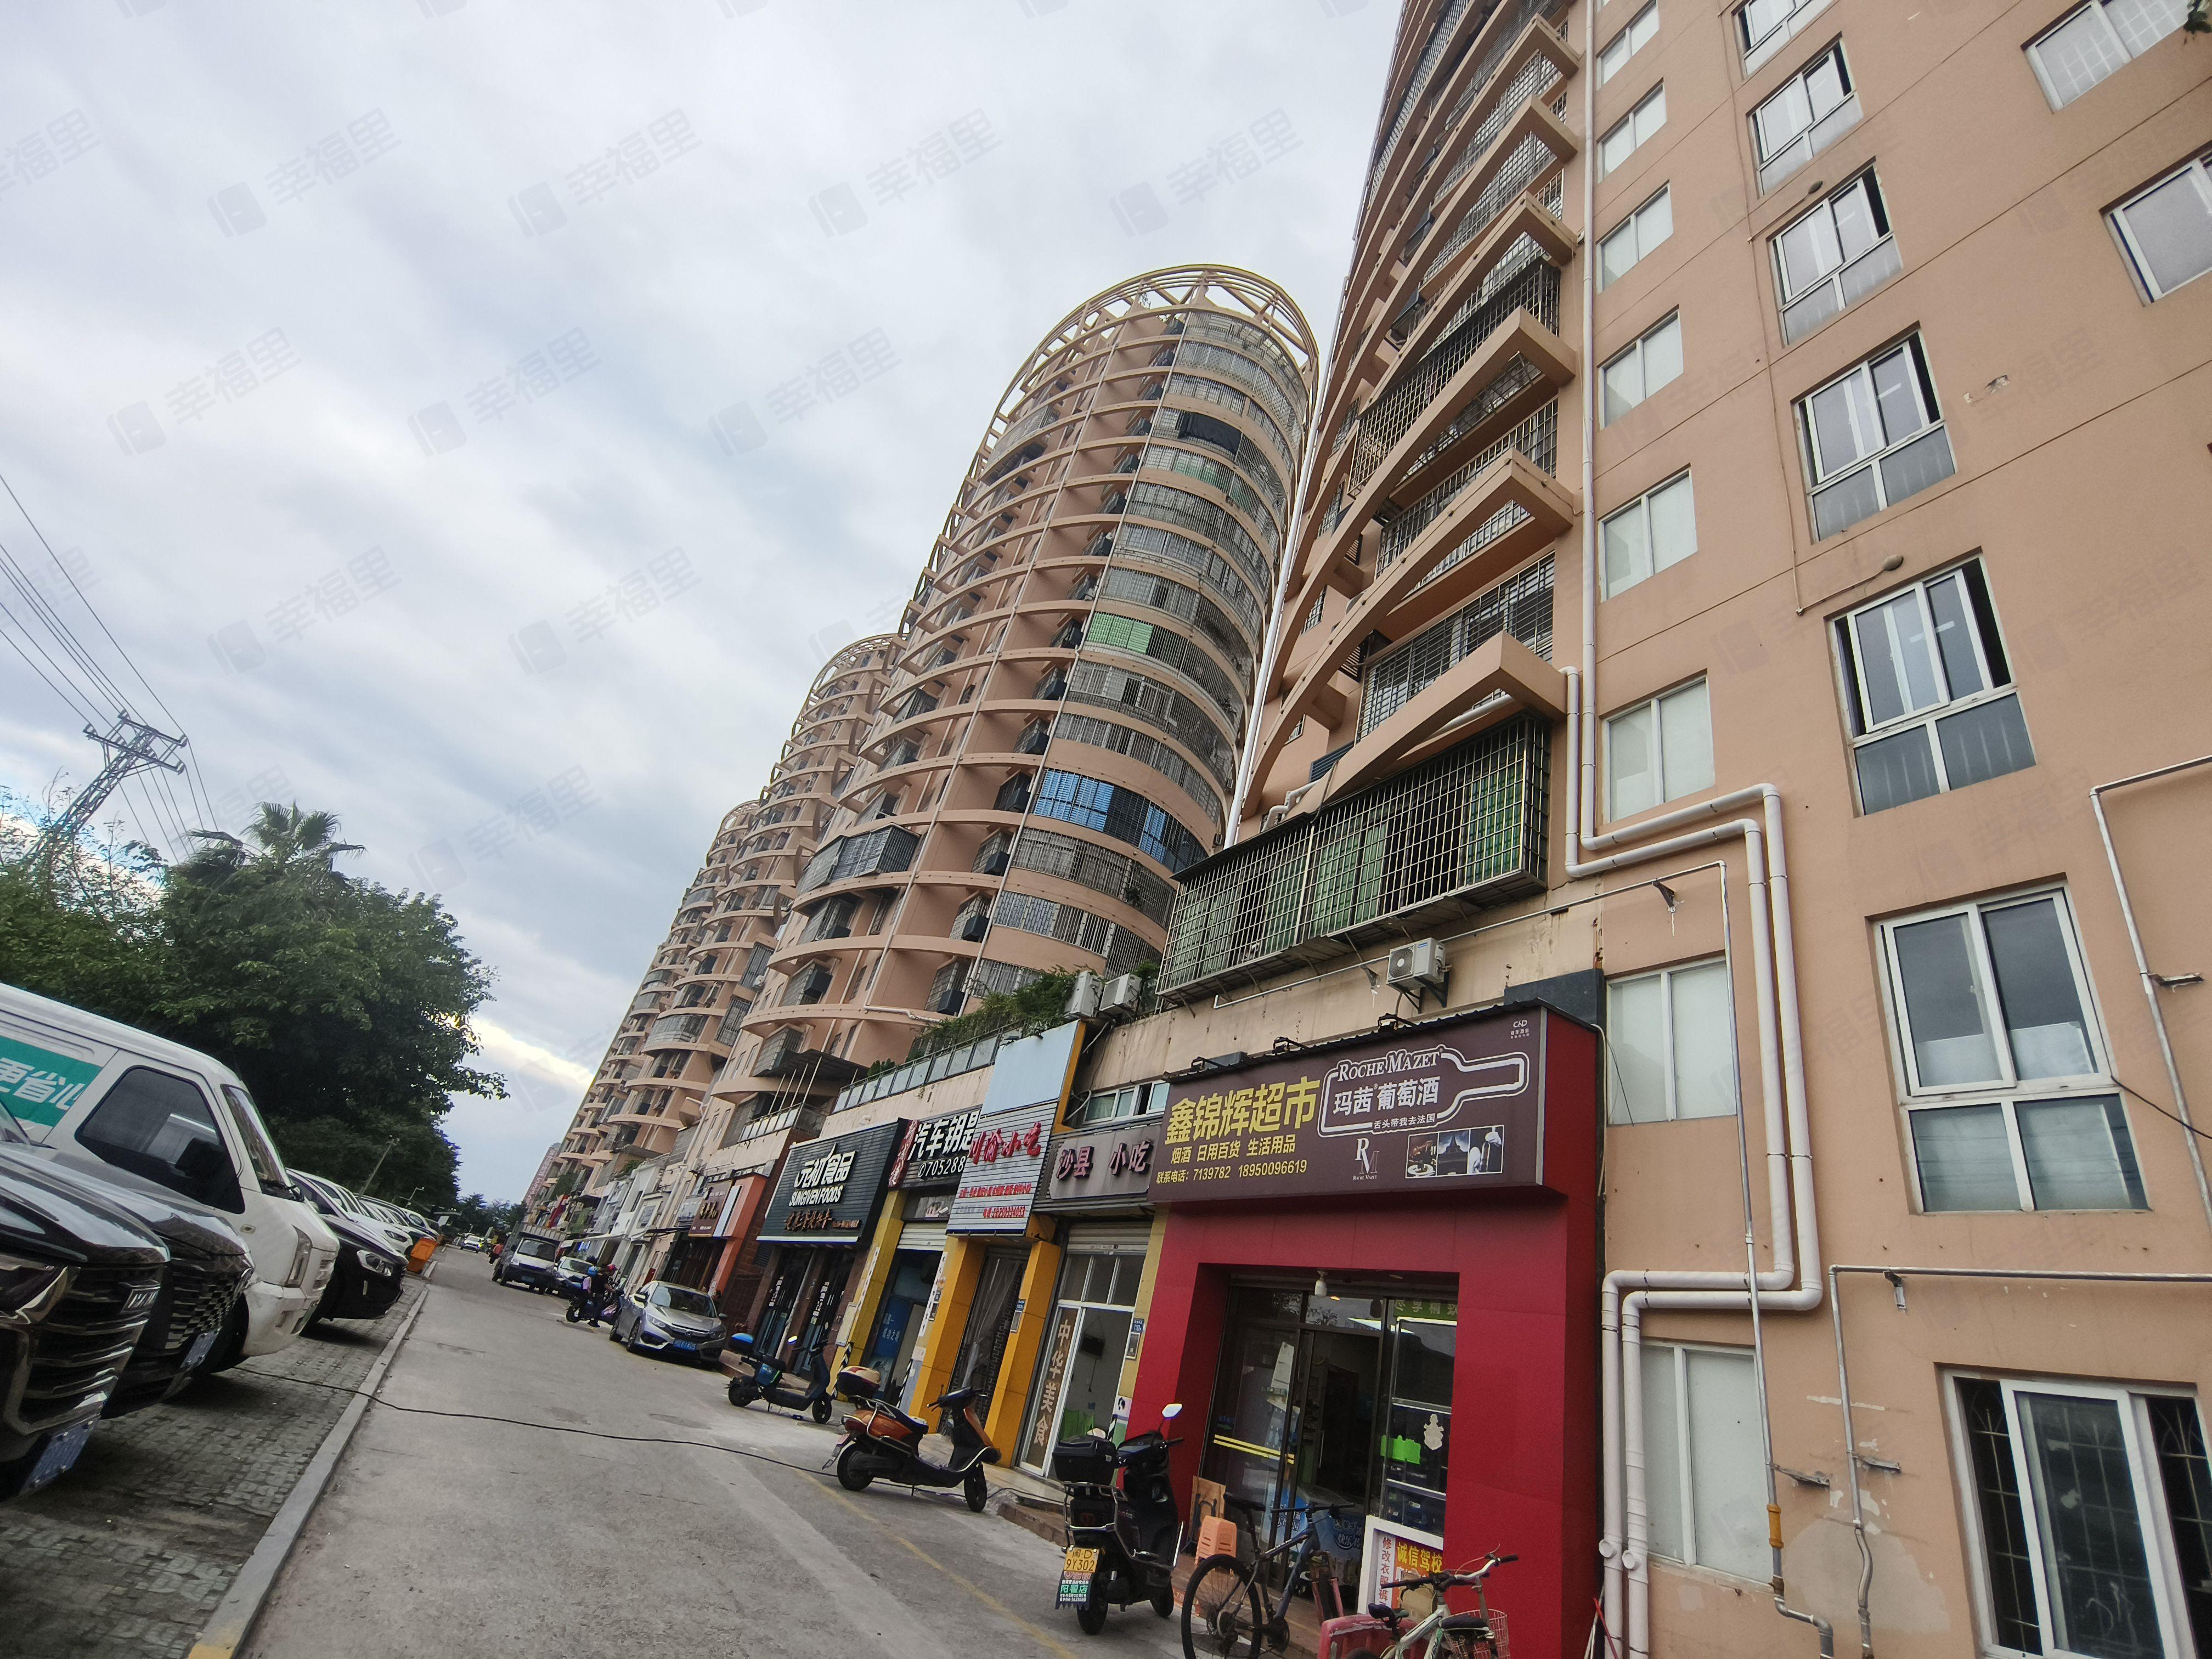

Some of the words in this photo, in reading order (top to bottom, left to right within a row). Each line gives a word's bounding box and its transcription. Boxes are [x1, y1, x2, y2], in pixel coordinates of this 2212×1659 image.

[1338, 1062, 1384, 1081] ROCHE
[1387, 1052, 1440, 1073] MAZET
[1165, 1076, 1320, 1144] 鑫锦辉超市
[1374, 1113, 1435, 1129] 舌头带我去法国
[1056, 1146, 1094, 1180] 沙县
[1108, 1139, 1151, 1176] 小吃
[1171, 1146, 1192, 1164] 烟酒
[1197, 1140, 1241, 1162] 日用百货
[1246, 1134, 1296, 1156] 生活用品
[1193, 1166, 1231, 1181] 7139782
[1238, 1159, 1307, 1177] 18950096619
[789, 1188, 821, 1206] SUNGIVEN
[819, 1184, 843, 1204] FOODS
[1034, 1319, 1071, 1447] 中华美食
[1066, 1559, 1095, 1571] 9Y302
[1379, 1537, 1392, 1605] 修改衣服裤
[1397, 1542, 1442, 1573] 诚信驾校
